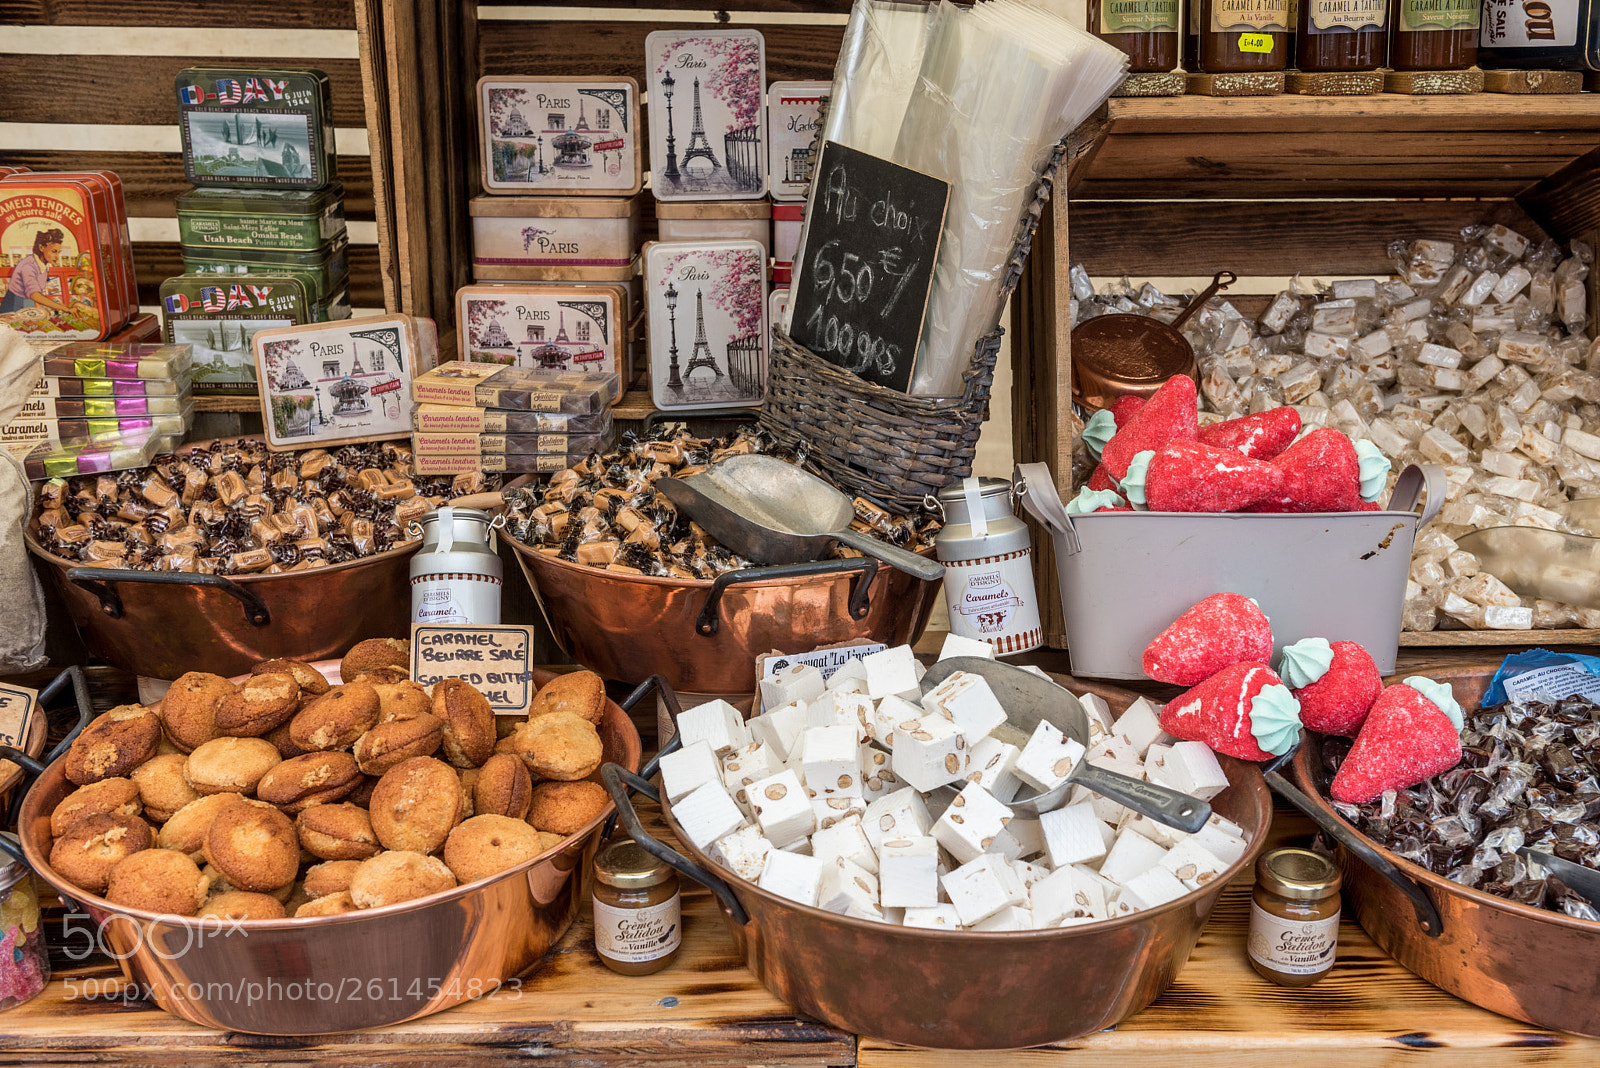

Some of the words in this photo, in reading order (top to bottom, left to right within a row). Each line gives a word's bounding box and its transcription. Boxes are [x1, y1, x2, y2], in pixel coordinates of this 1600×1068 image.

[1110, 2, 1141, 13] CARAMEL
[1222, 0, 1253, 11] CARAMEL
[1319, 0, 1350, 13] CARAMEL
[1410, 0, 1442, 12] CARAMEL
[1122, 15, 1143, 23] Saveur
[675, 53, 707, 69] Paris
[180, 78, 289, 105] D-DAY
[293, 90, 312, 99] JUIN
[536, 93, 571, 109] PARIS
[824, 163, 857, 224] Au
[870, 190, 928, 245] choix
[5, 214, 15, 223] au
[15, 209, 43, 218] beurre
[35, 198, 82, 225] TENDRES
[204, 235, 225, 243] Utah
[251, 231, 279, 239] Omaha
[280, 232, 303, 240] Beach
[537, 237, 579, 254] PARIS
[677, 265, 710, 281] Paris
[165, 285, 273, 313] D-DAY
[277, 295, 296, 304] JUIN
[272, 304, 294, 313] 1944
[515, 305, 550, 321] PARIS
[310, 342, 344, 357] PARIS
[417, 385, 446, 394] Caramels
[422, 414, 453, 422] Caramels
[2, 423, 48, 434] Caramels
[419, 437, 450, 445] Caramels
[966, 589, 1009, 602] Caramels
[419, 606, 457, 618] Caramels
[421, 633, 502, 647] CARAMEL
[421, 649, 484, 662] BEURRE
[489, 643, 525, 661] SALÉ
[1513, 674, 1536, 686] CARAMEL
[618, 920, 652, 930] Crème
[615, 926, 663, 941] Salidou
[1280, 931, 1317, 942] Crème
[629, 941, 658, 950] Vanille
[1276, 941, 1326, 951] Salidou
